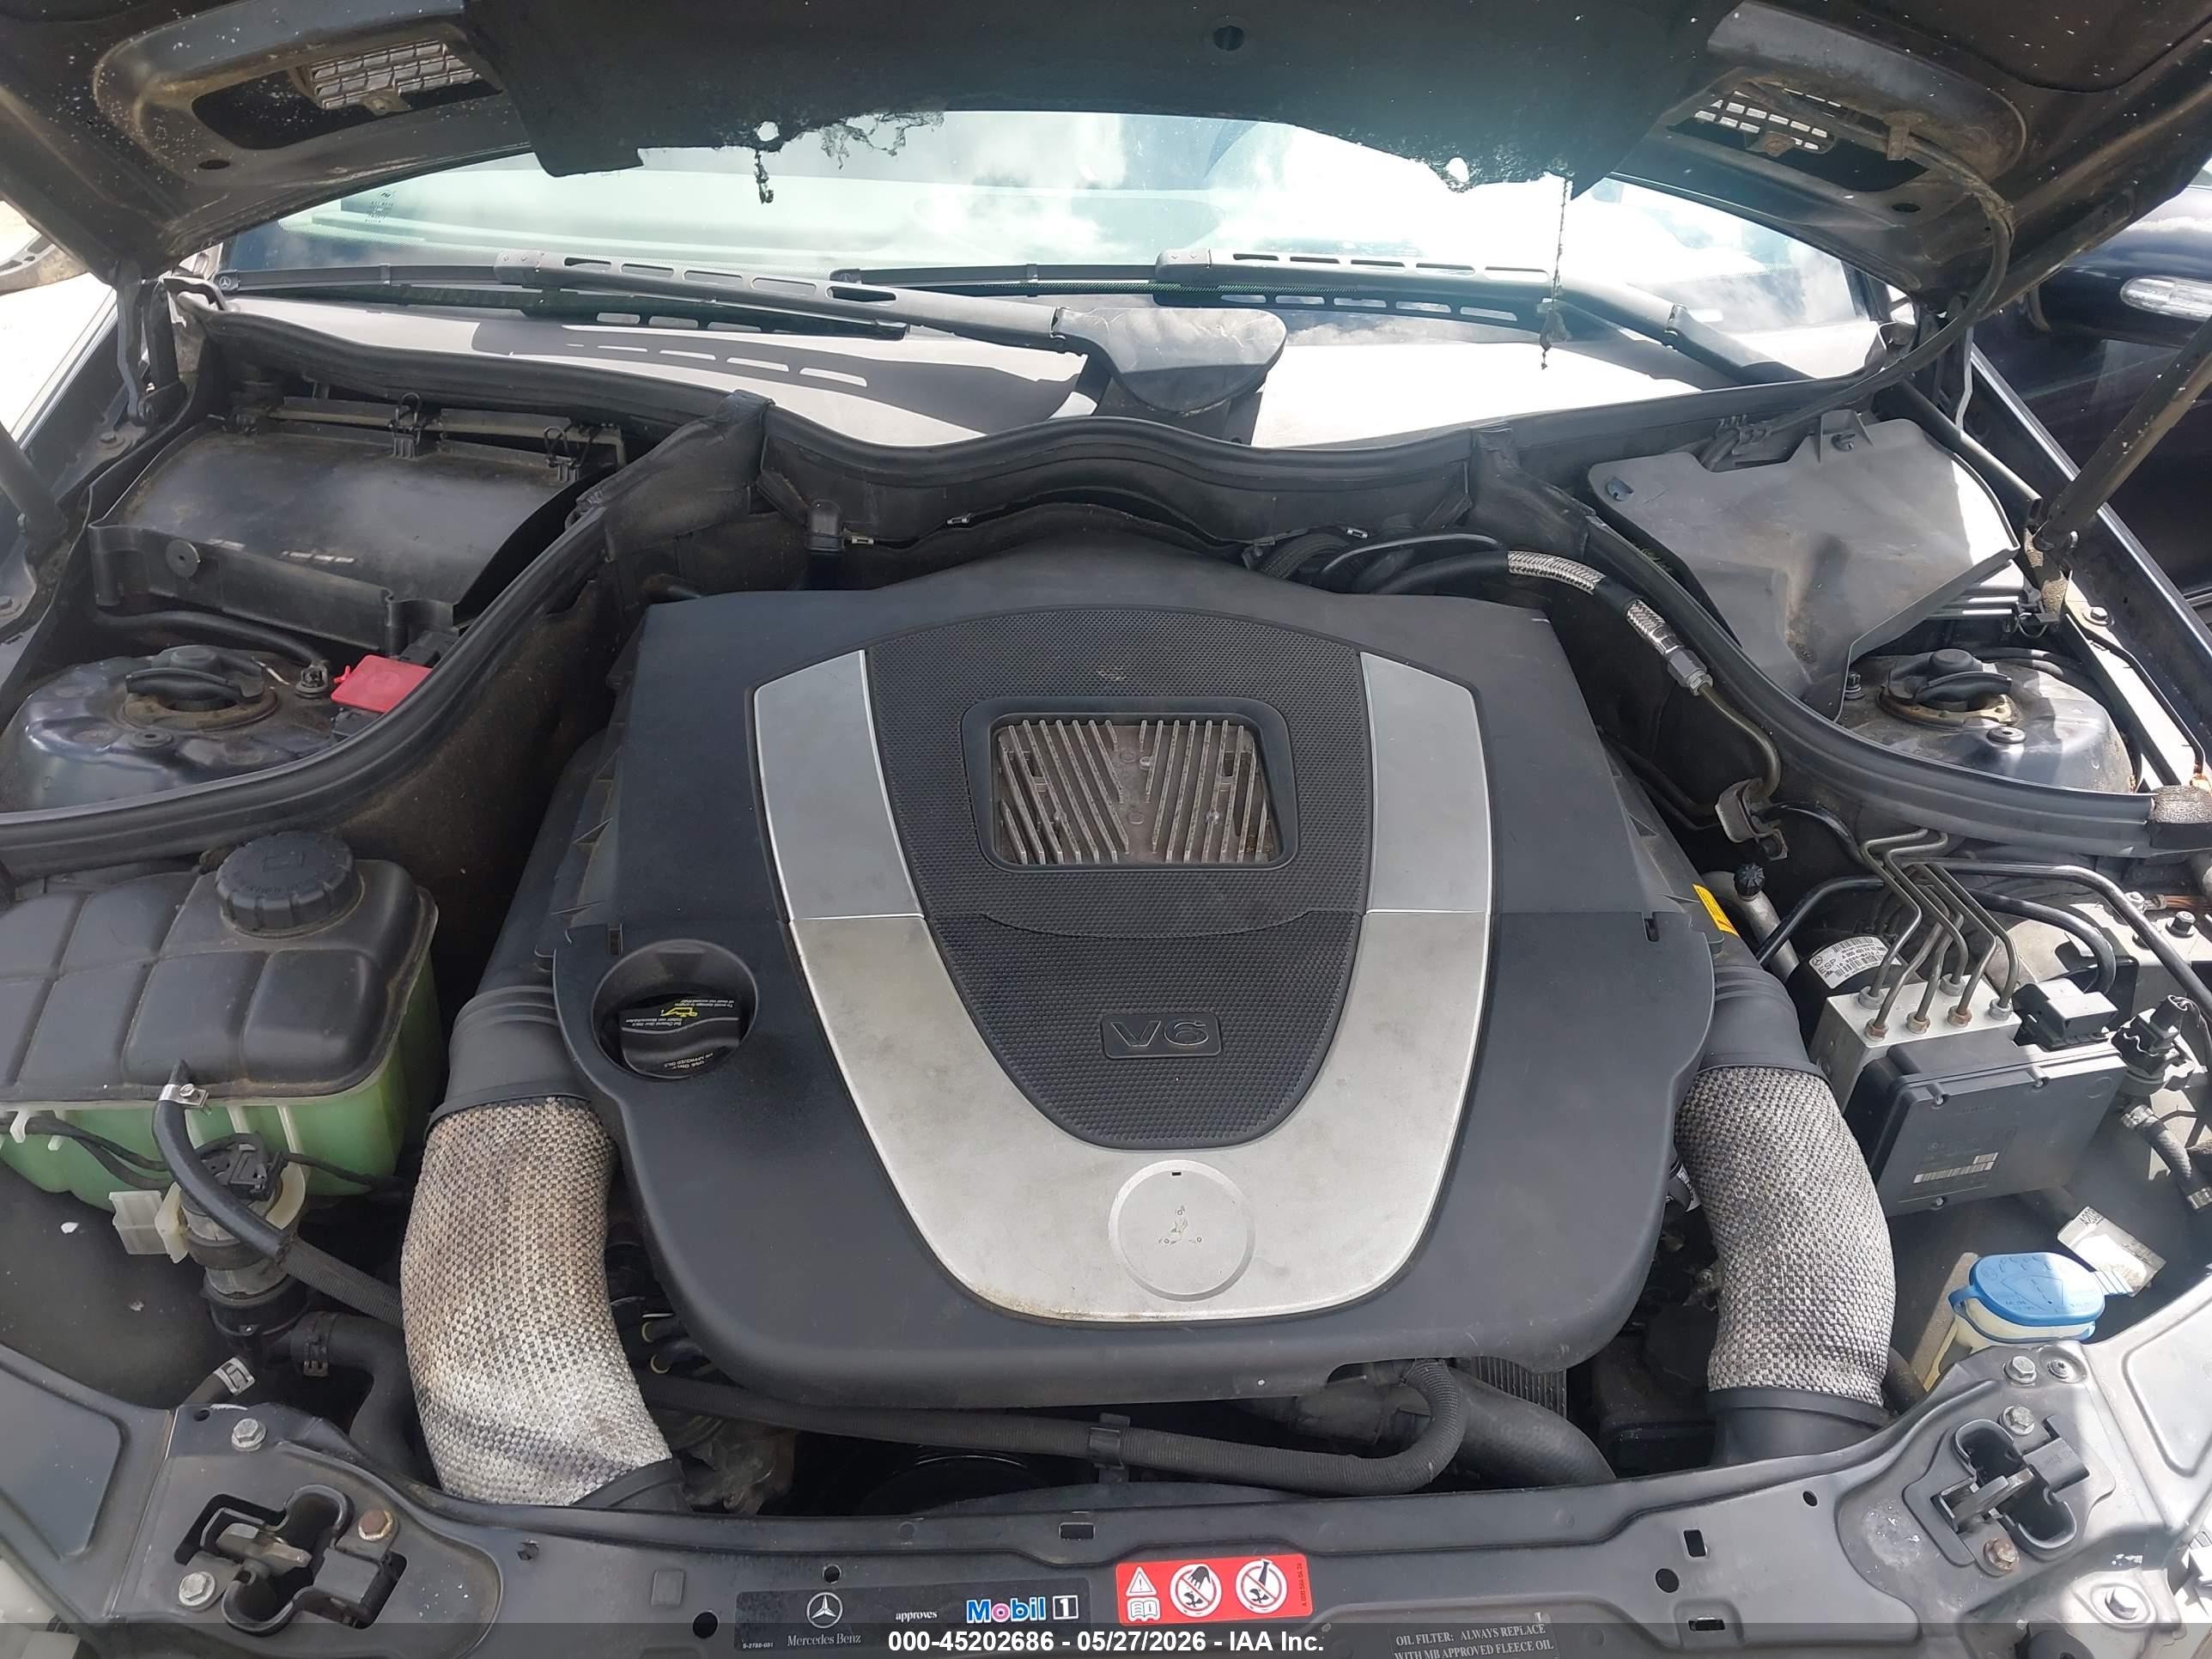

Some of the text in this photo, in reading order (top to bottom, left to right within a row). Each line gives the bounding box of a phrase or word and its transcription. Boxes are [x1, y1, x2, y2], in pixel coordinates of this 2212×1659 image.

[1818, 958, 1837, 975] ESP
[1110, 1018, 1209, 1046] V6
[896, 1610, 938, 1622] approves
[966, 1595, 1047, 1624] Mobil
[787, 1632, 861, 1647] Mercedes Benz
[1395, 1635, 1414, 1646] OIL
[1415, 1632, 1455, 1644] FILTER:
[1460, 1627, 1499, 1641] ALWAYS
[1394, 1638, 1554, 1659] WITH MB APPROVED FLEECE OIL
